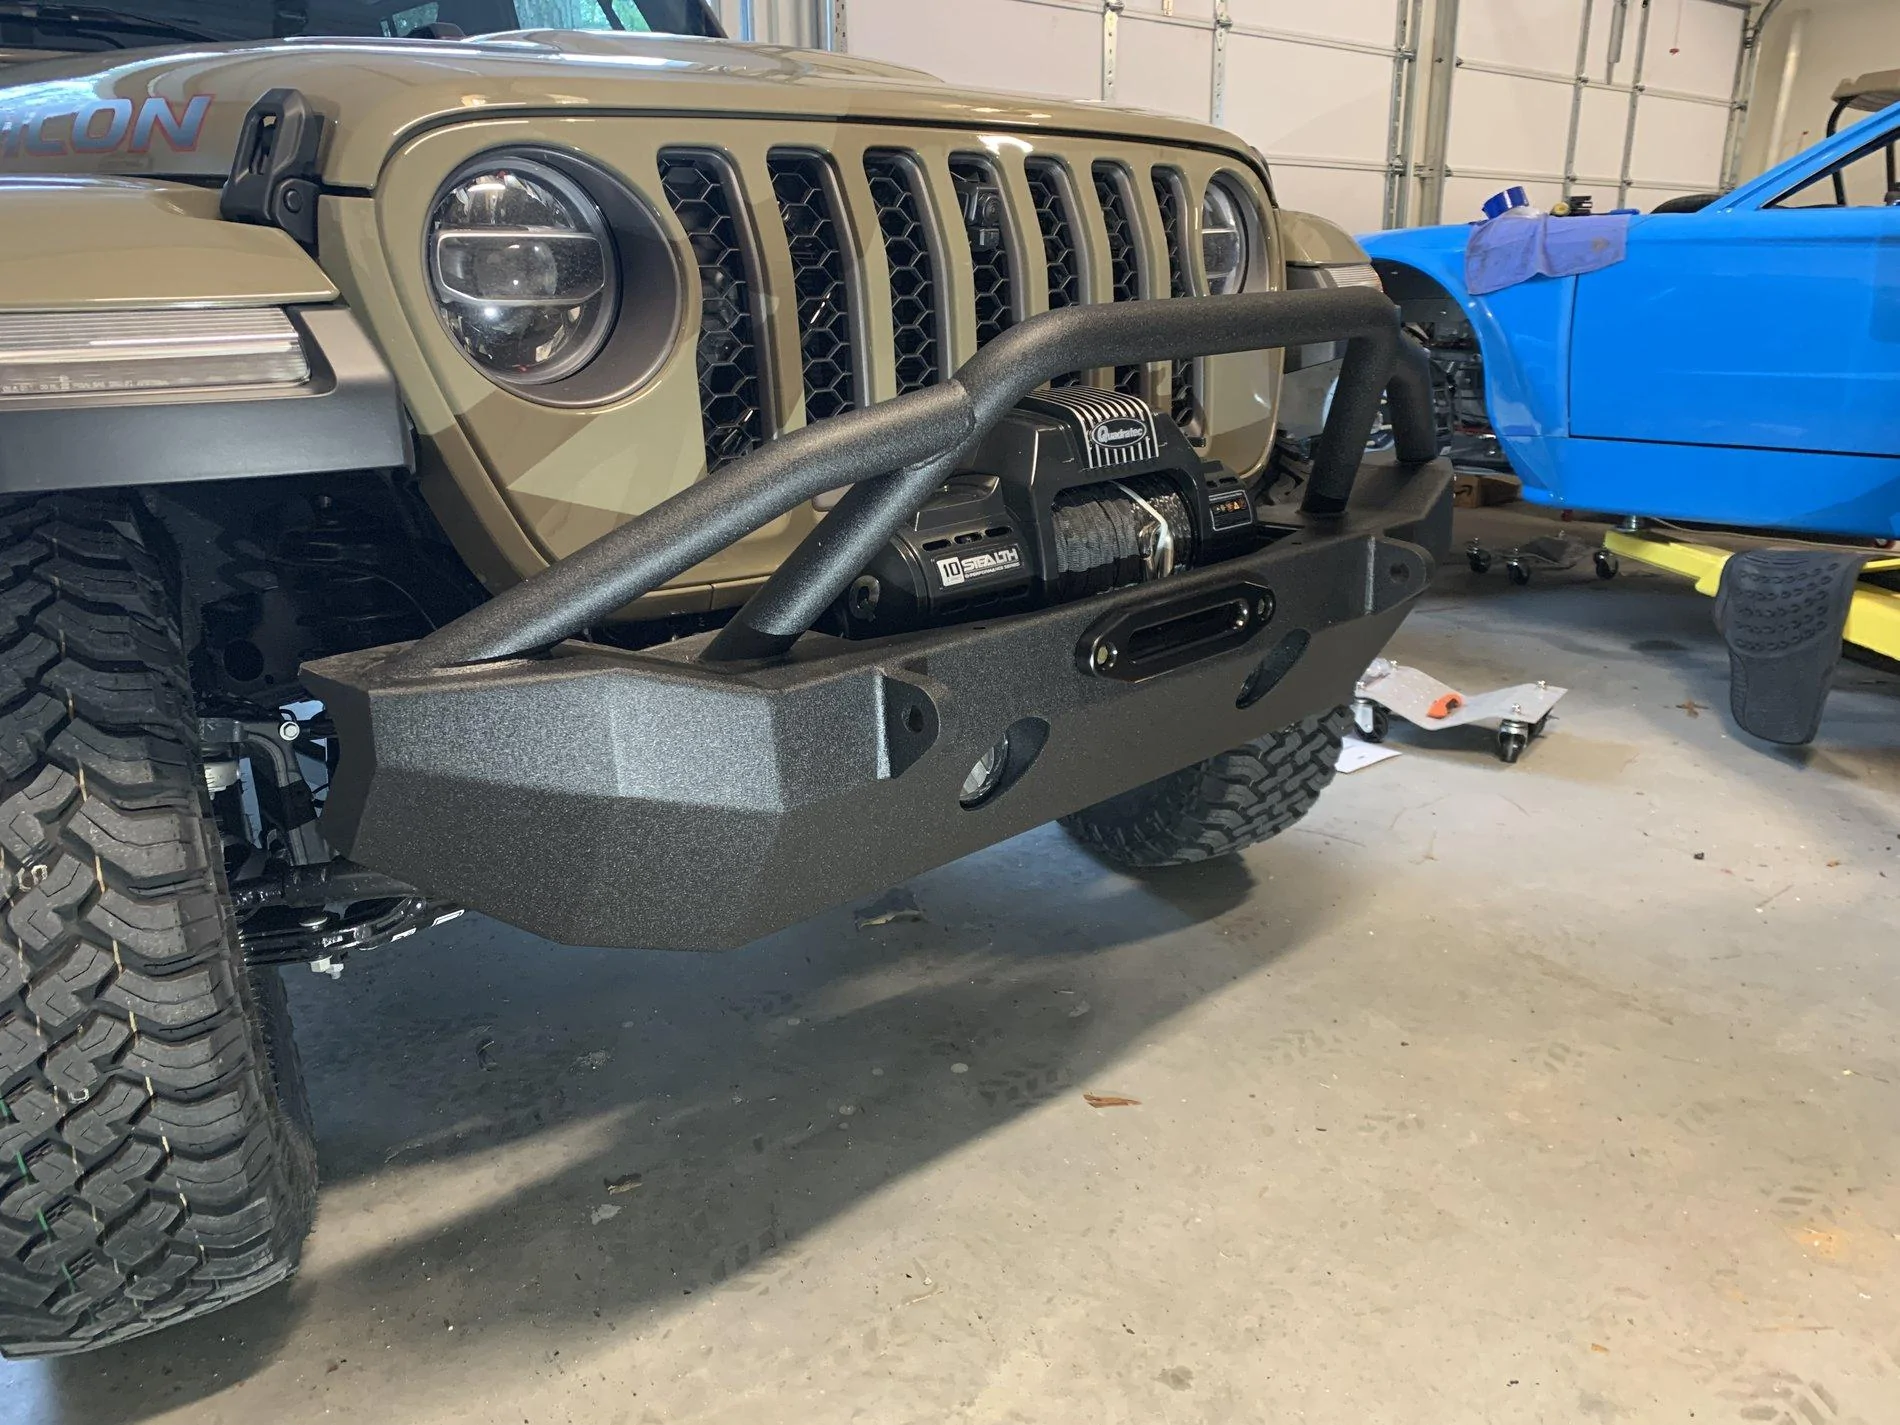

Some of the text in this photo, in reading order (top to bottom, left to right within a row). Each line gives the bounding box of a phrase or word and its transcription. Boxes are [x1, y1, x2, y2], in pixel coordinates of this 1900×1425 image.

[1097, 425, 1143, 443] Quadratec
[943, 548, 1019, 578] 10 STEALTH
